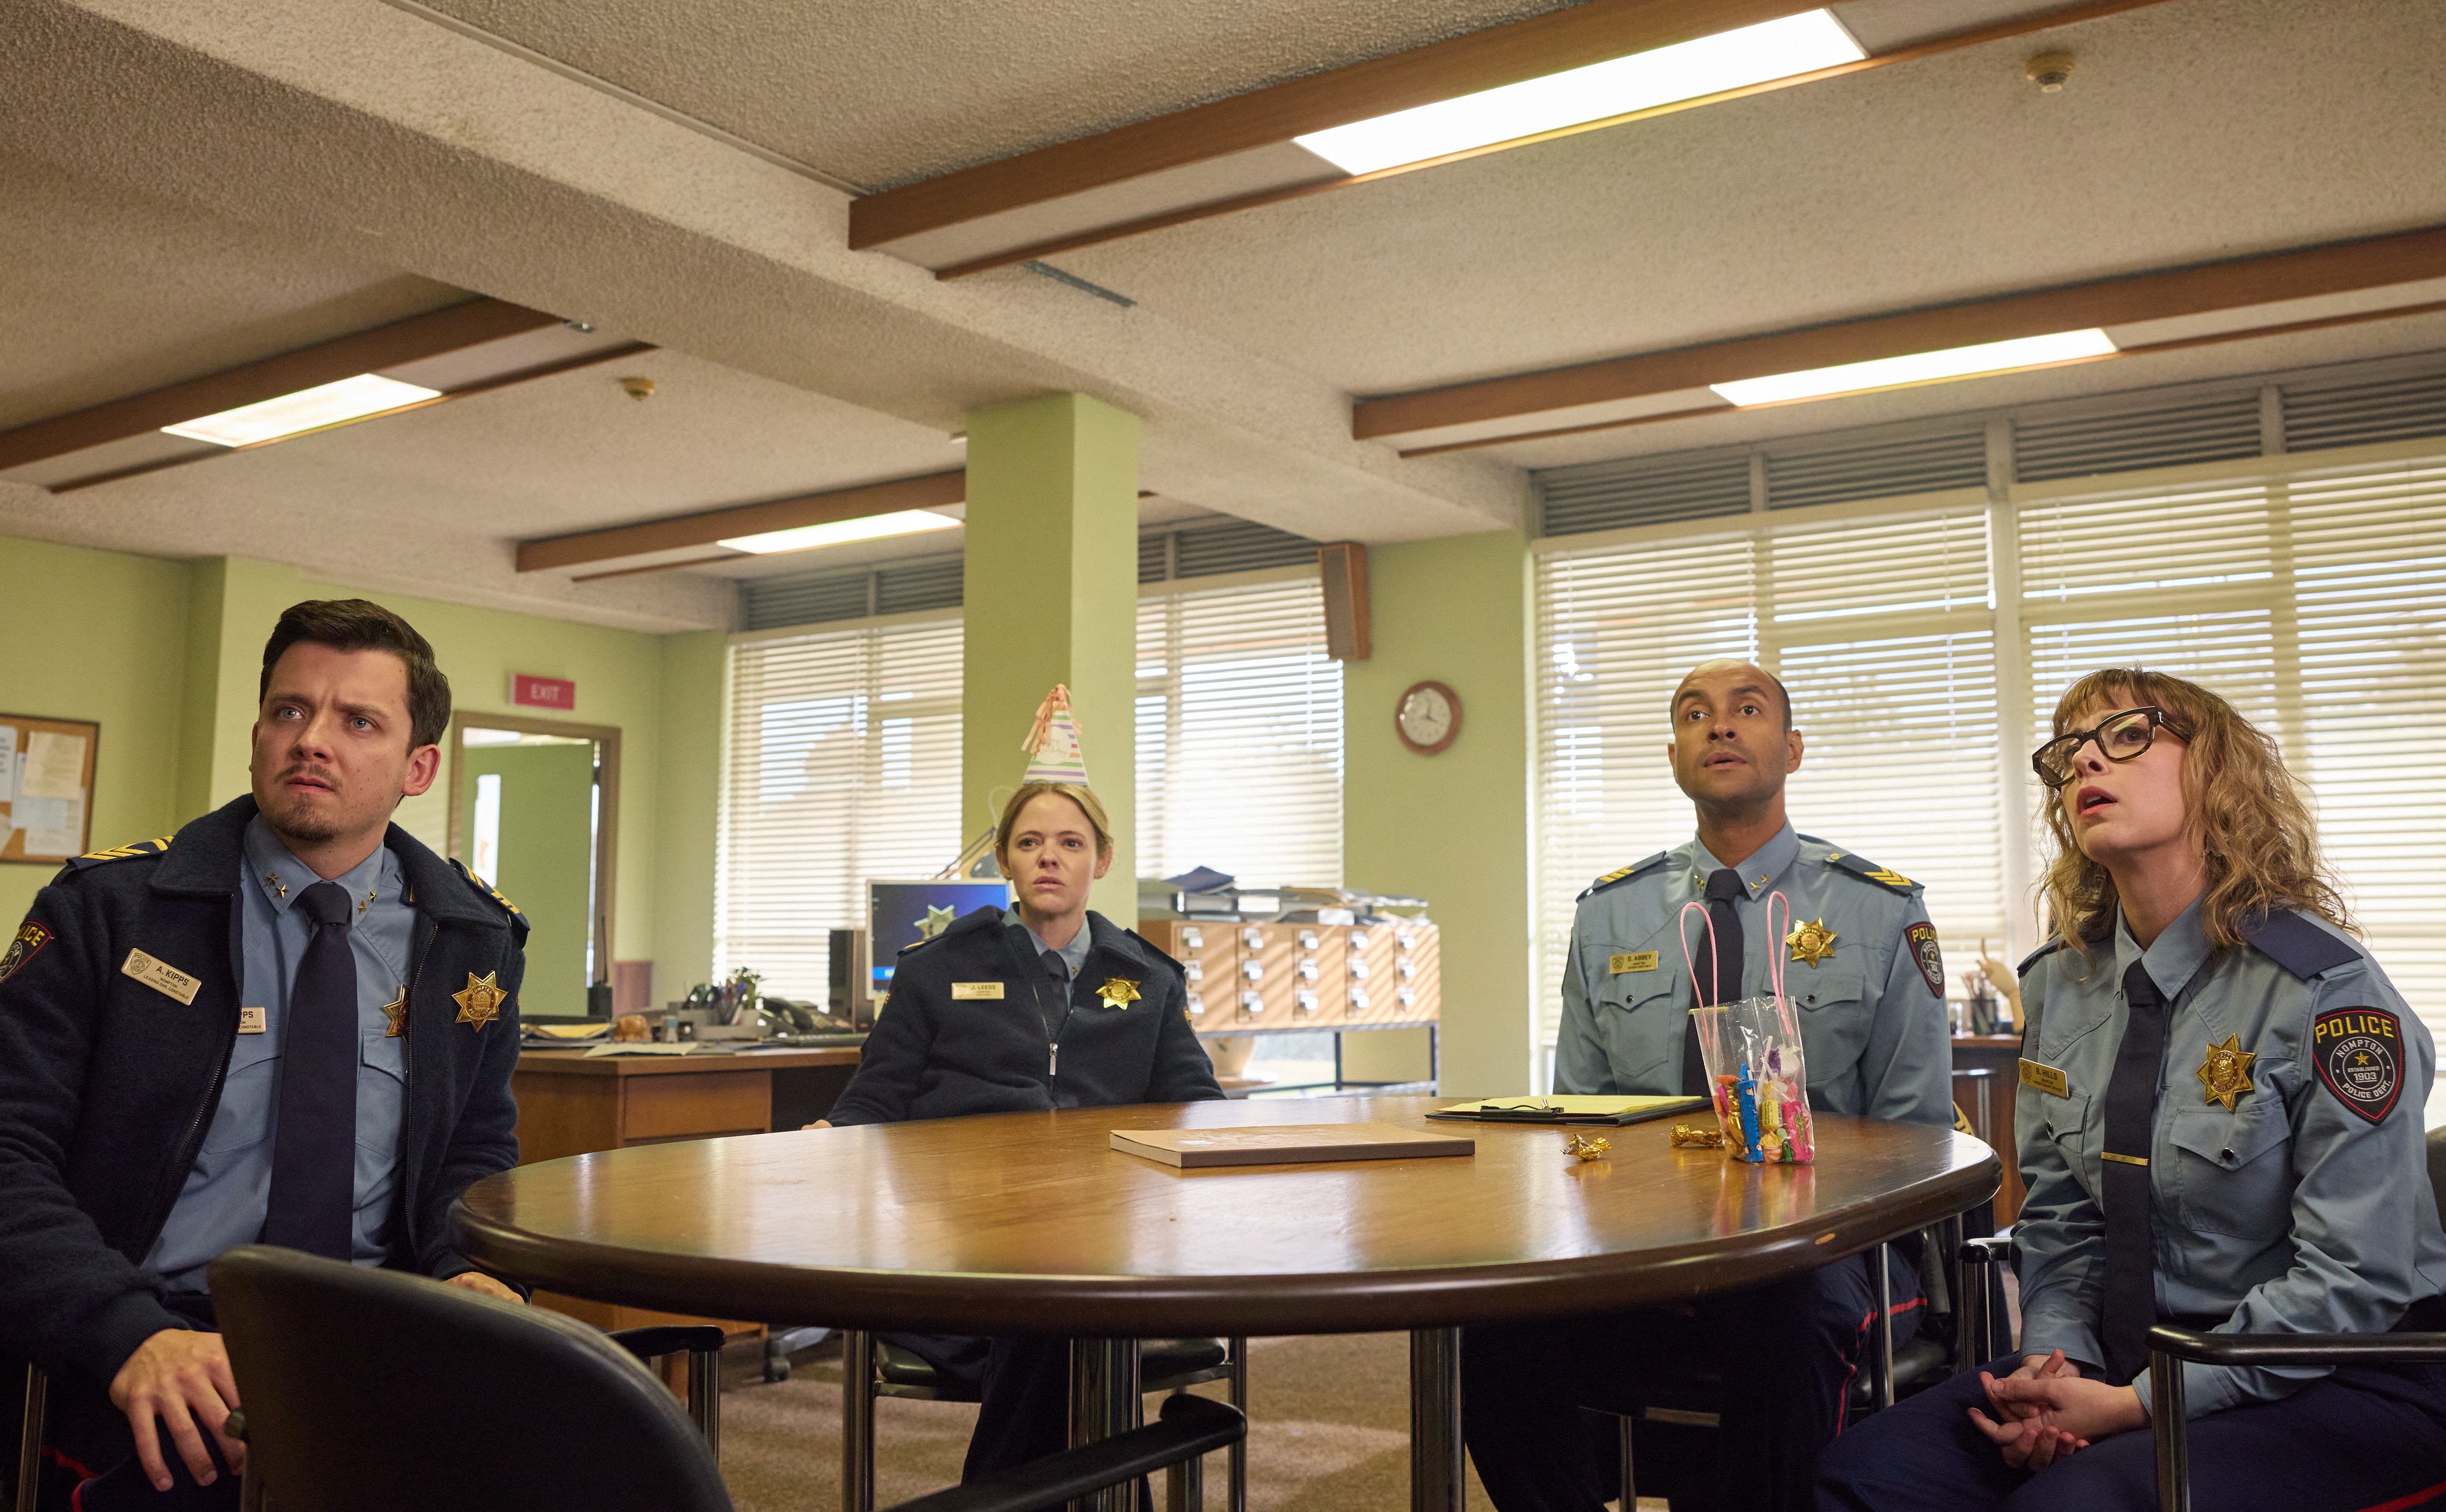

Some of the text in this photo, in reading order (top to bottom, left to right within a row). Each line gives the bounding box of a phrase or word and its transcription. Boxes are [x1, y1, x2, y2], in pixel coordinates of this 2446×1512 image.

[531, 683, 559, 701] EXIT
[1912, 927, 1938, 942] POLIC
[134, 954, 149, 964] POLICE
[156, 966, 189, 986] A. KIPPS
[160, 977, 178, 988] NOMPTON
[144, 974, 159, 985] LEADING
[169, 988, 189, 999] CONSTABLE
[470, 986, 492, 995] NOMPTON
[2314, 1015, 2395, 1044] POLICE
[2336, 1039, 2383, 1058] NOMPTON
[2042, 1069, 2057, 1080] HILLS
[2353, 1072, 2377, 1080] 1903
[2342, 1080, 2392, 1098] POLICE DEPT.
